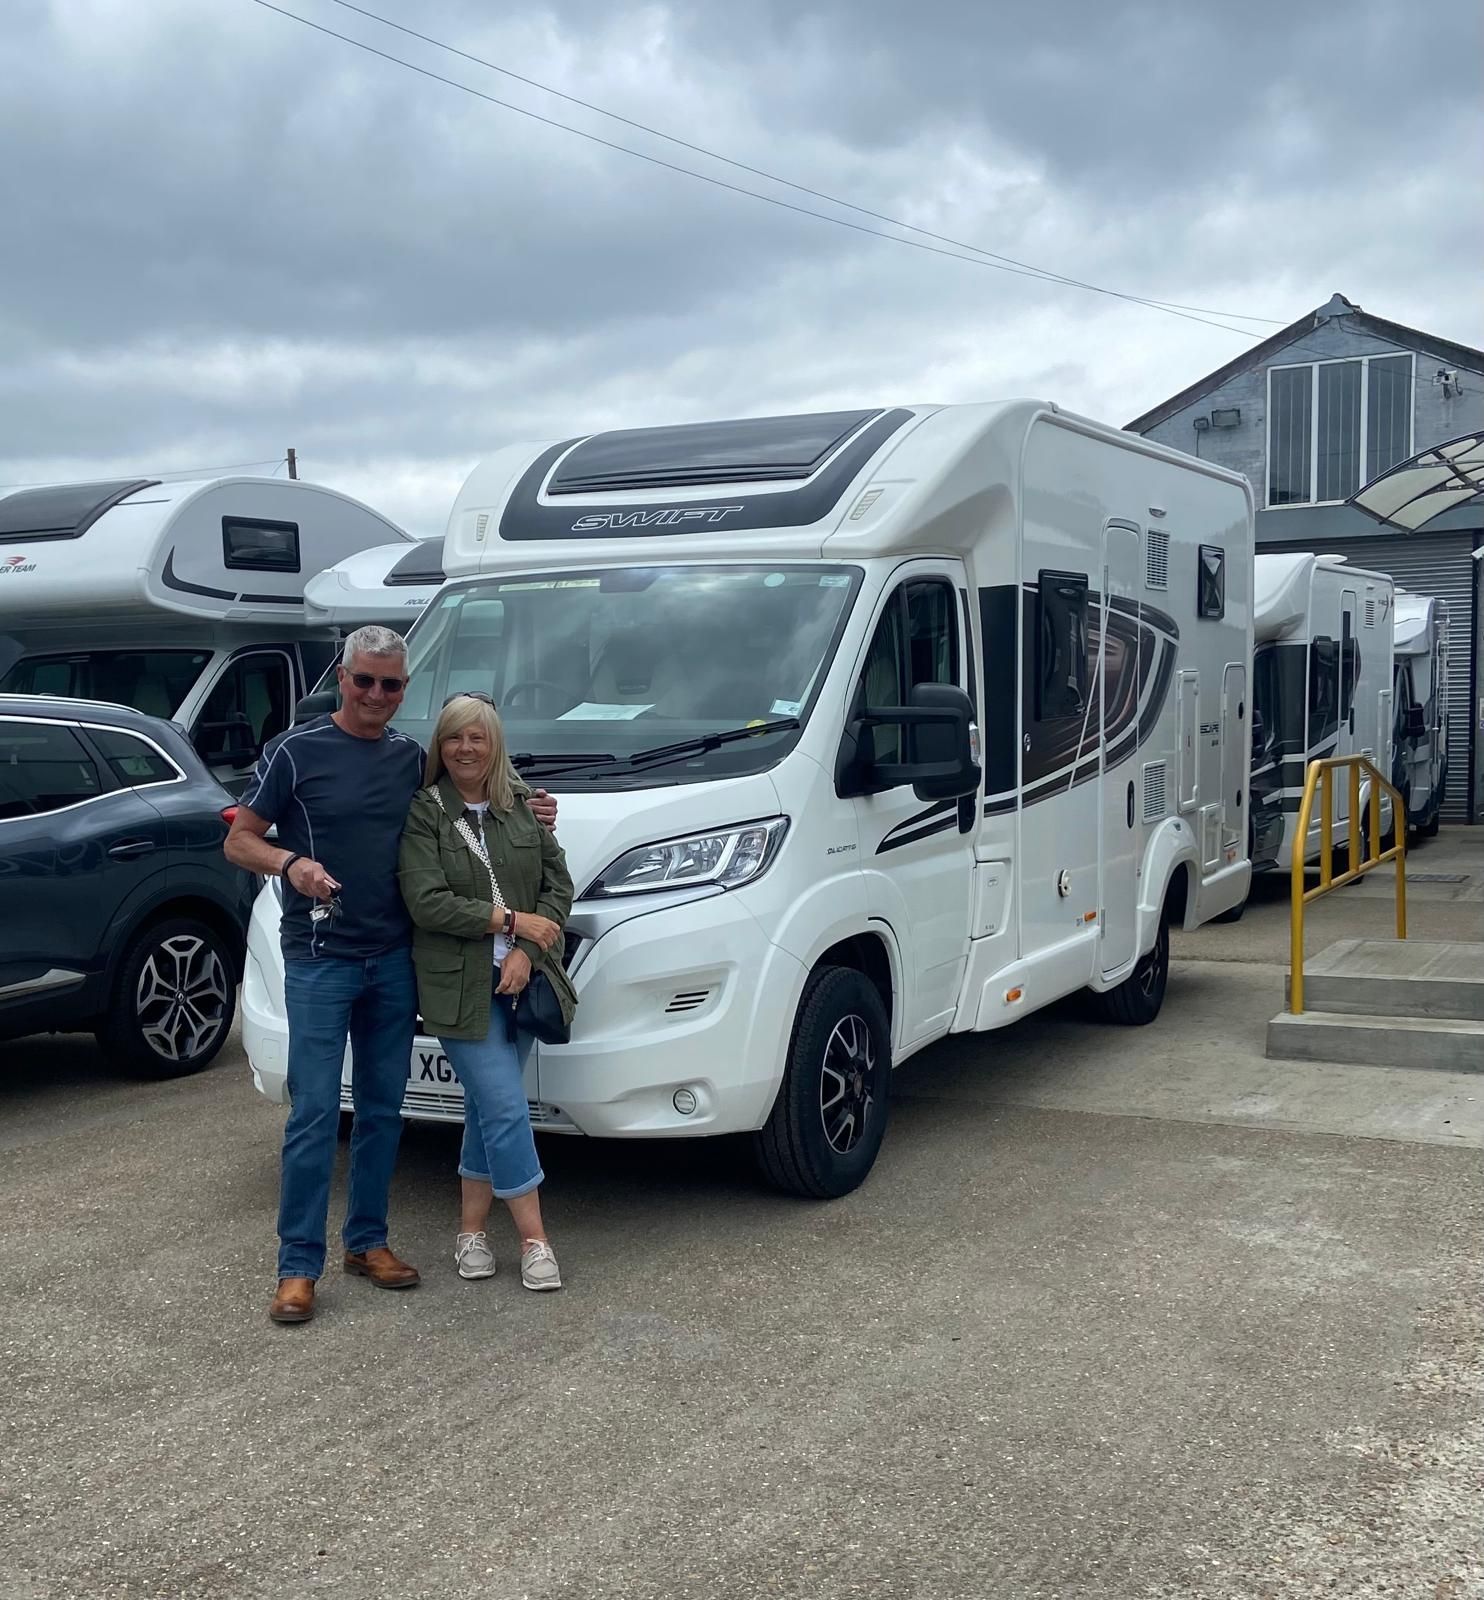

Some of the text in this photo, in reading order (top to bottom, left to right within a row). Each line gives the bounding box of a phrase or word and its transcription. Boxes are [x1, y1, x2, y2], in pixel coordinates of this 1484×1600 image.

[571, 505, 744, 531] SWIFT
[12, 564, 37, 573] TEAM
[419, 1053, 460, 1083] XG
